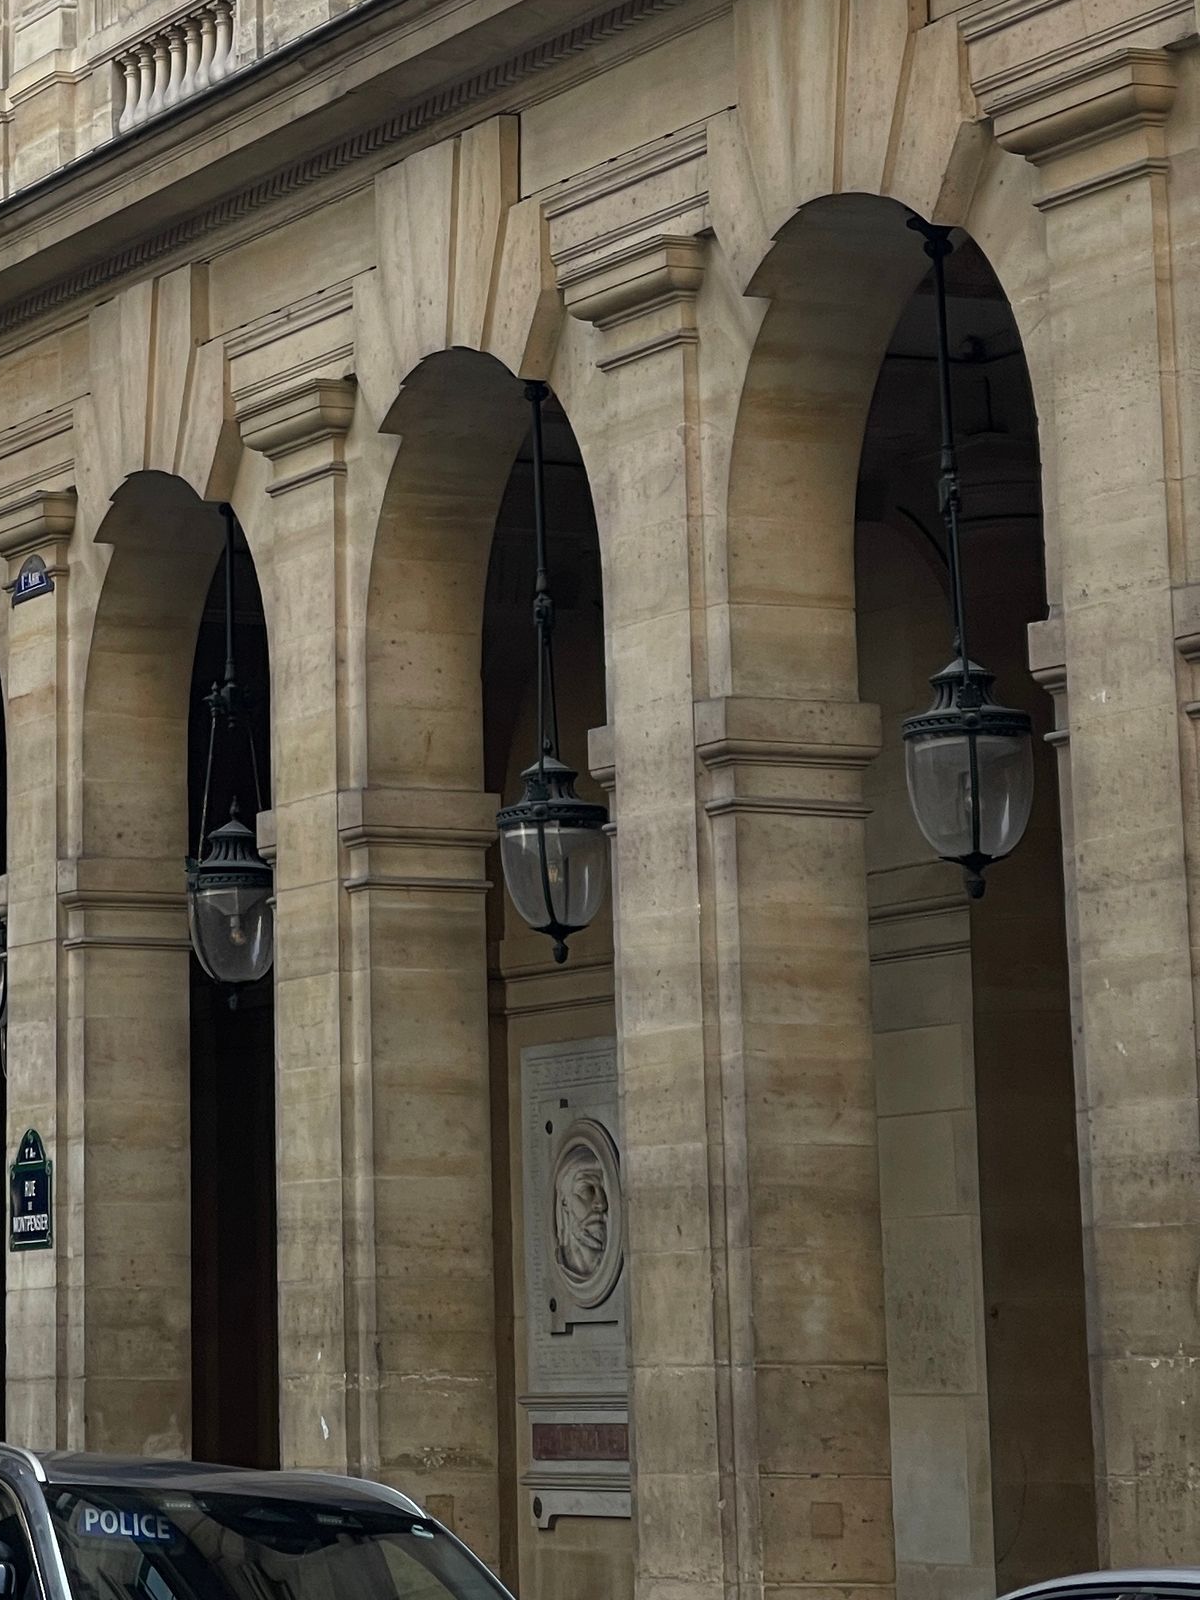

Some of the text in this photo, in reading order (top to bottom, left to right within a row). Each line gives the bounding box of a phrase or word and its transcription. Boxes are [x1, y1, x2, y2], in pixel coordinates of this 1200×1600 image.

[24, 1180, 36, 1197] RUE
[13, 1213, 49, 1233] MONTPENSIER
[85, 1508, 170, 1539] POLICE
